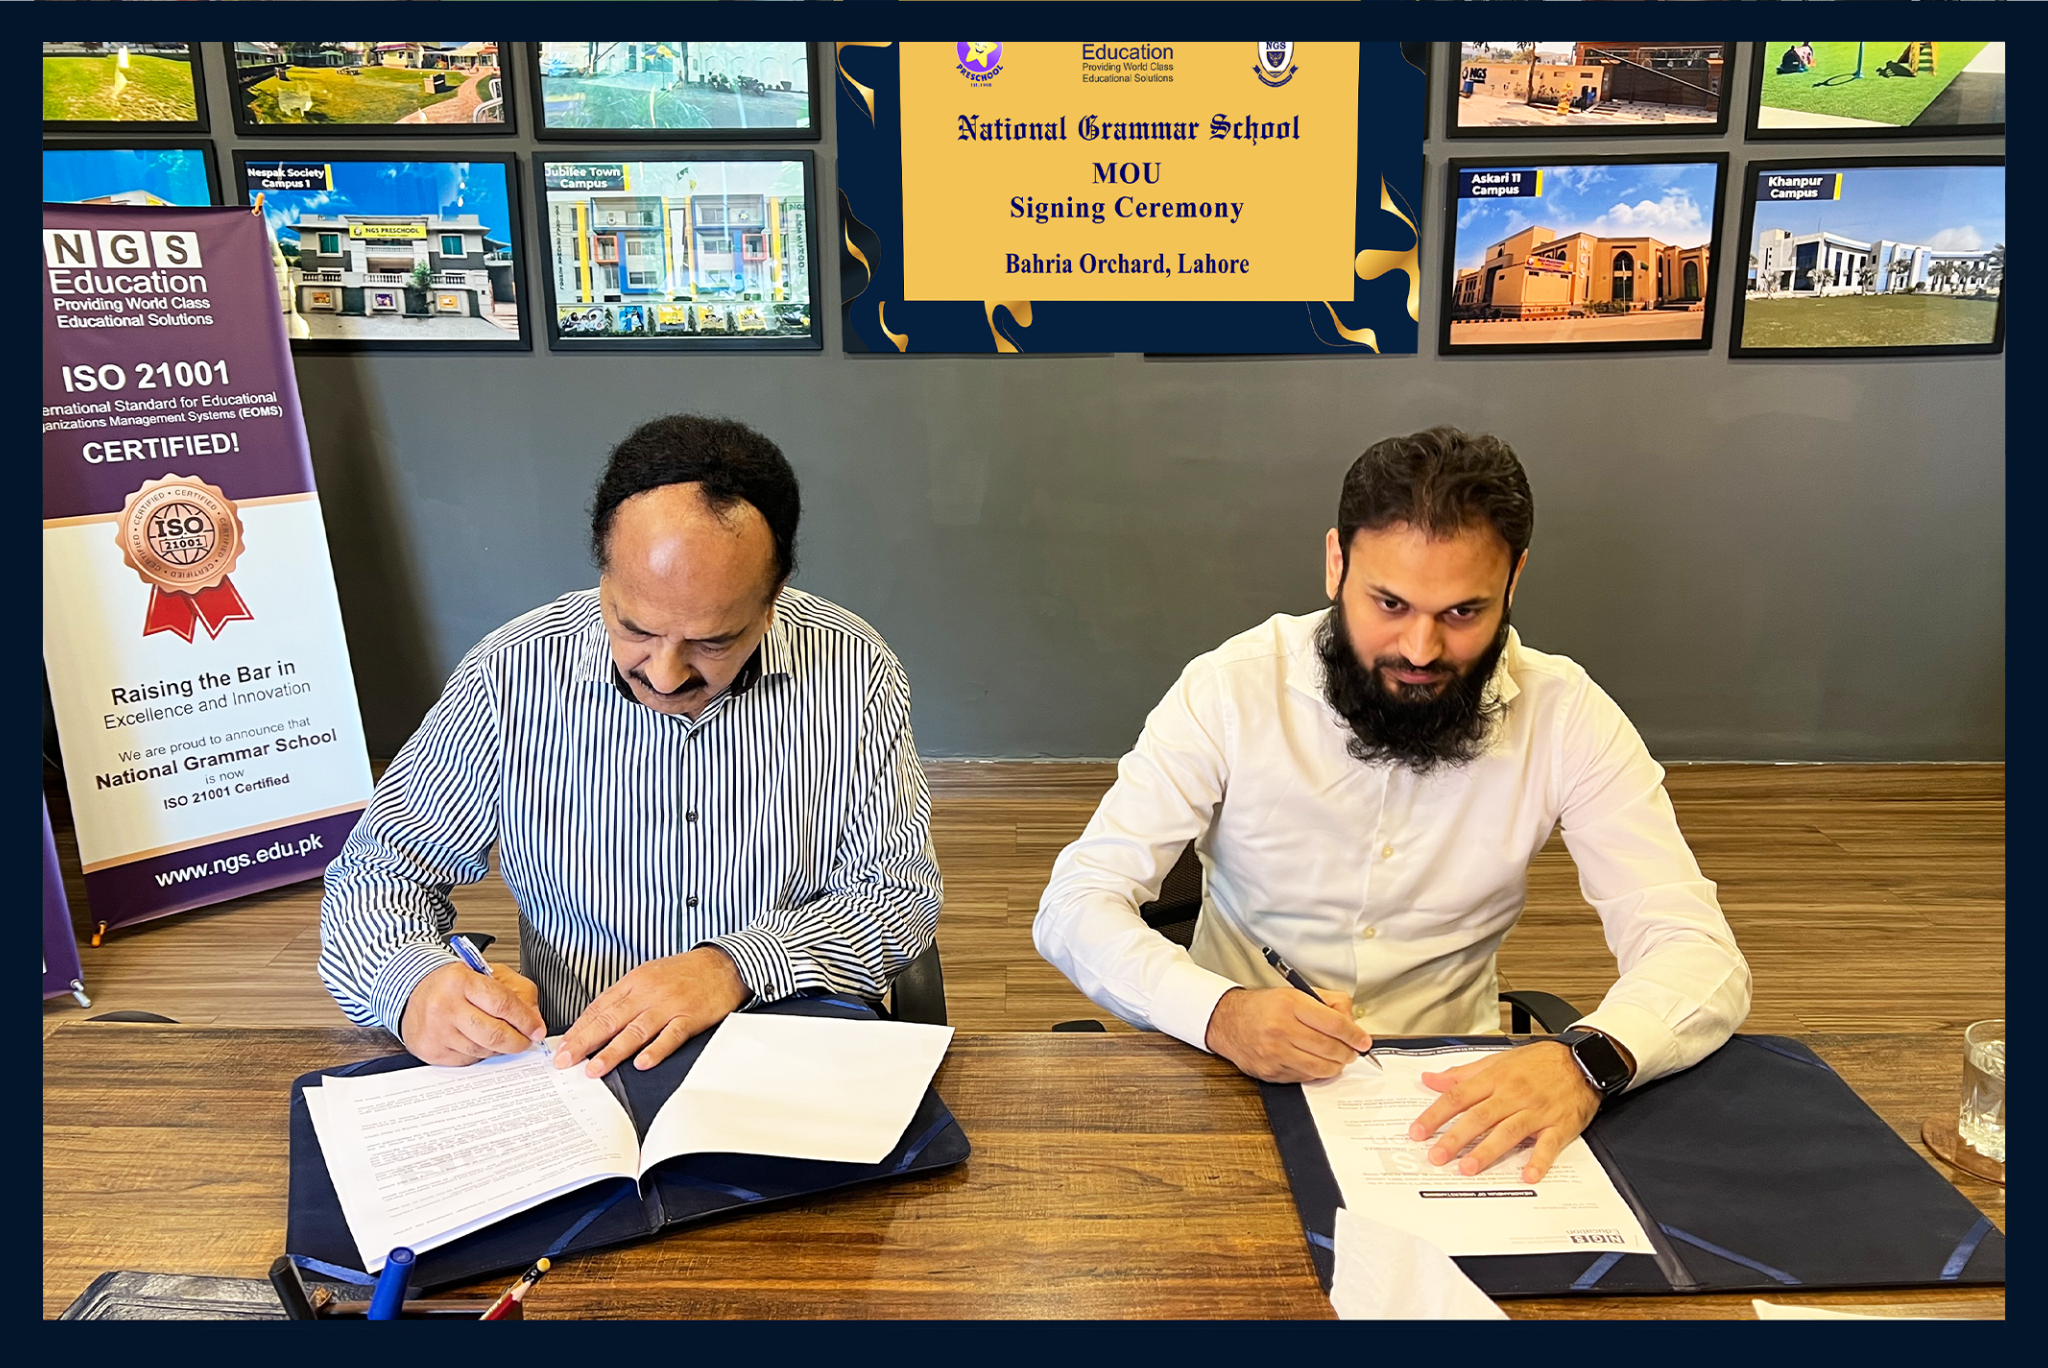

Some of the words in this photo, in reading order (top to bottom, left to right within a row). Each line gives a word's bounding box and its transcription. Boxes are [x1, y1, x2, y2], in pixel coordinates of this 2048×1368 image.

[1082, 43, 1173, 60] Education
[956, 64, 1003, 81] PRESCHOOL
[1082, 62, 1121, 73] Providing
[1123, 62, 1148, 71] World
[1150, 62, 1174, 71] Class
[1082, 73, 1132, 82] Educational
[1134, 73, 1174, 82] Solutions
[1470, 68, 1487, 78] NGS
[957, 114, 1068, 142] National
[1078, 114, 1200, 142] Grammar
[1209, 113, 1300, 146] School
[247, 168, 286, 178] Nespak
[287, 168, 324, 179] Society
[545, 167, 587, 176] Jubilee
[589, 167, 621, 176] Town
[1092, 162, 1161, 184] MOU
[1471, 172, 1509, 184] Askari
[1512, 173, 1521, 182] 11
[262, 179, 304, 189] Campus
[305, 179, 311, 188] 1
[560, 179, 608, 190] Campus
[1472, 186, 1519, 196] Campus
[1768, 176, 1823, 188] Khanpur
[1770, 188, 1818, 200] Campus
[1010, 196, 1106, 224] Signing
[1114, 196, 1244, 224] Ceremony
[53, 234, 188, 264] NGS
[1005, 253, 1073, 274] Bahria
[1079, 253, 1172, 278] Orchard,
[1178, 253, 1250, 274] Lahore
[48, 270, 208, 294] Education
[53, 298, 123, 313] Providing
[125, 298, 167, 310] World
[170, 297, 210, 309] Class
[57, 315, 144, 328] Educational
[148, 313, 213, 326] Solutions
[62, 364, 126, 392] ISO
[135, 360, 229, 389] 21001
[114, 398, 177, 412] Standard
[180, 397, 198, 408] for
[202, 392, 277, 407] Educational
[110, 412, 186, 427] Management
[188, 408, 236, 423] Systems
[238, 406, 283, 420] (EOMS)
[82, 432, 240, 463] CERTIFIED!
[134, 492, 165, 526] CERTIFIED
[175, 489, 216, 511] CERTIFIED
[156, 517, 203, 537] ISO
[165, 538, 203, 550] 21001
[218, 517, 229, 558] CERTIFIED
[133, 534, 161, 572] CERTIFIED
[171, 563, 214, 578] CERTIFIED
[111, 678, 193, 705] Raising
[198, 671, 231, 689] the
[237, 664, 271, 683] Bar
[277, 660, 296, 676] in
[104, 703, 194, 730] Excellence
[198, 694, 227, 712] and
[232, 680, 311, 705] Innovation
[118, 749, 142, 763] We
[145, 746, 166, 758] are
[170, 737, 206, 755] proud
[210, 734, 222, 745] to
[225, 723, 284, 741] announce
[288, 716, 310, 729] that
[95, 760, 178, 790] National
[183, 744, 270, 771] Grammar
[275, 728, 337, 752] School
[205, 774, 216, 785] is
[219, 769, 244, 782] now
[163, 795, 188, 810] ISO
[192, 787, 231, 804] 21001
[235, 774, 290, 794] Certified
[155, 833, 323, 888] www.ngs.edu.pk
[1570, 1235, 1625, 1243] NGS
